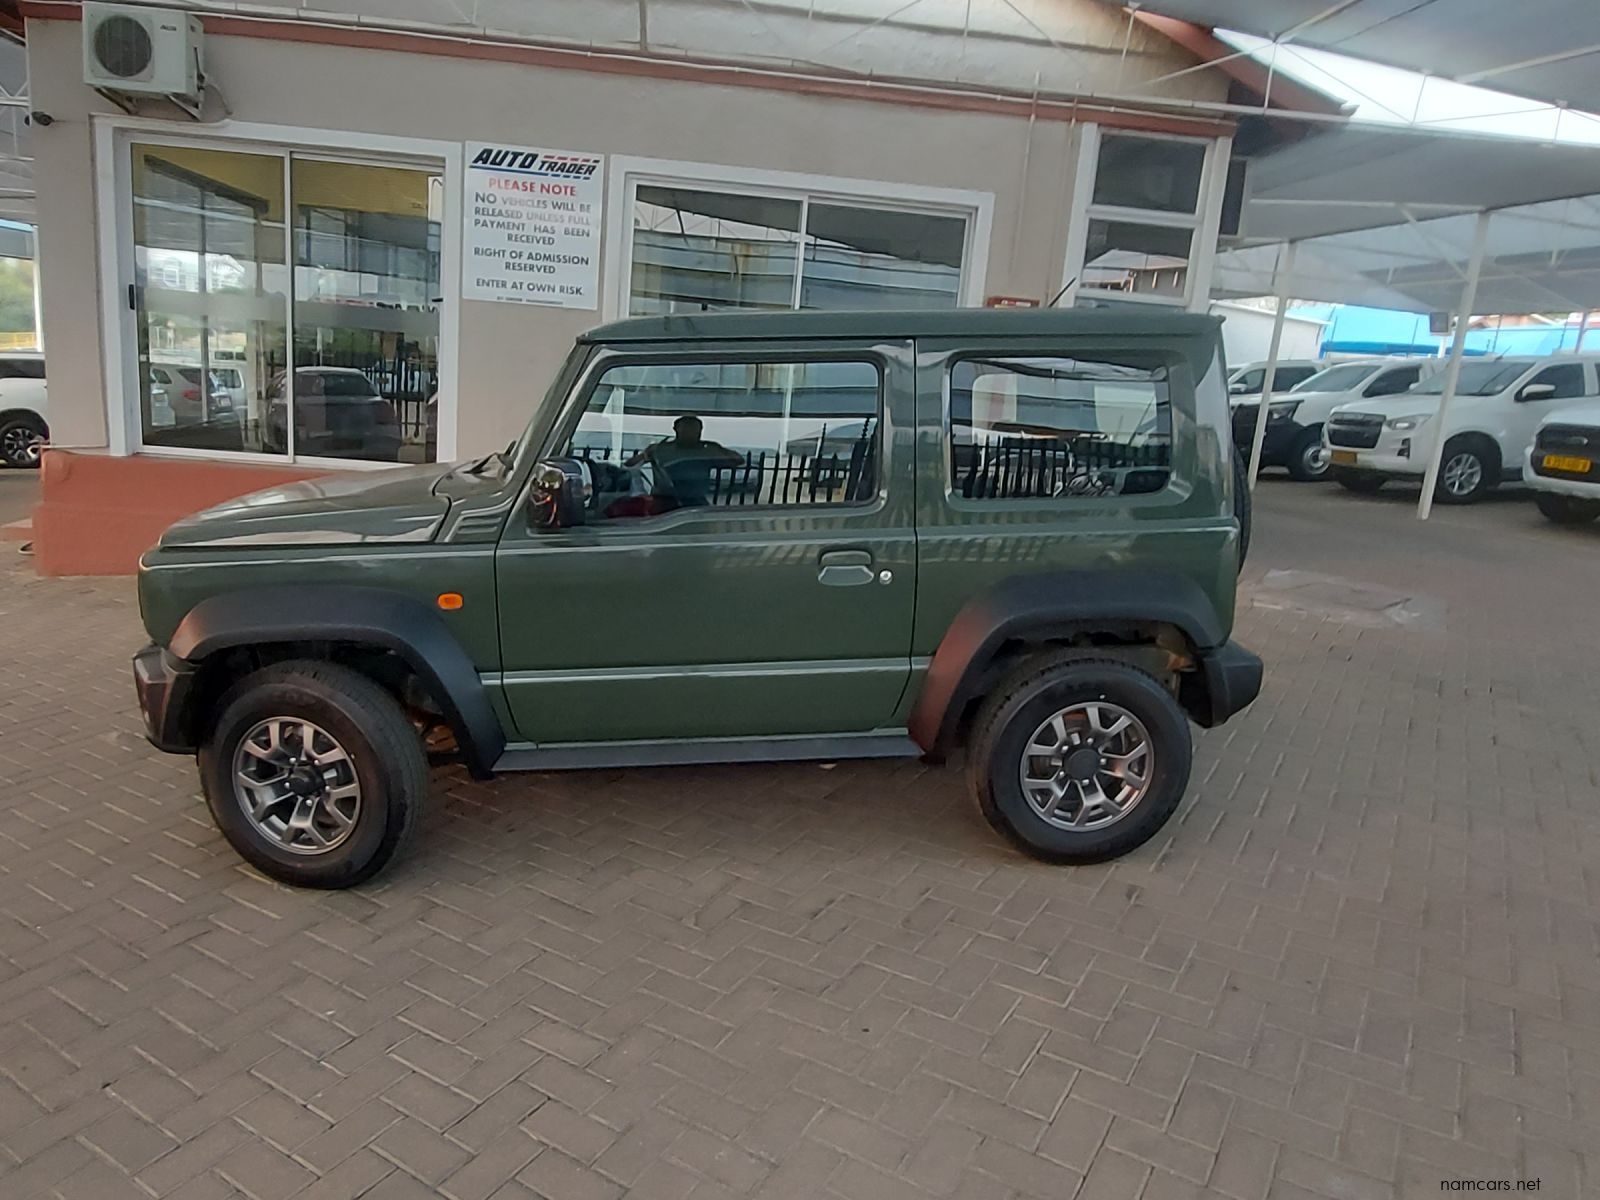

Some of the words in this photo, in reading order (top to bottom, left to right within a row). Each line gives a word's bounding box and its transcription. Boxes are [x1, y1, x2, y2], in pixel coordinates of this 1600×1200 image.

[472, 148, 539, 169] AUTO
[538, 160, 598, 176] TRADER
[488, 177, 535, 193] PLEASE
[540, 182, 577, 196] NOTE
[475, 192, 497, 205] NO
[501, 196, 547, 209] VEHICLES
[551, 201, 576, 212] WILL
[579, 203, 591, 213] BE
[474, 206, 523, 219] RELEASED
[526, 211, 565, 223] UNLESS
[568, 216, 591, 226] FULL
[474, 219, 526, 232] PAYMENT
[533, 225, 556, 235] HAS
[564, 228, 590, 238] BEEN
[507, 233, 555, 246] RECEIVED
[473, 247, 506, 259] RIGHT
[509, 250, 524, 260] OF
[526, 252, 590, 266] ADMISSION
[505, 261, 556, 274] RESERVED
[476, 278, 507, 289] ENTER
[510, 281, 524, 291] AT
[527, 282, 556, 293] OWN
